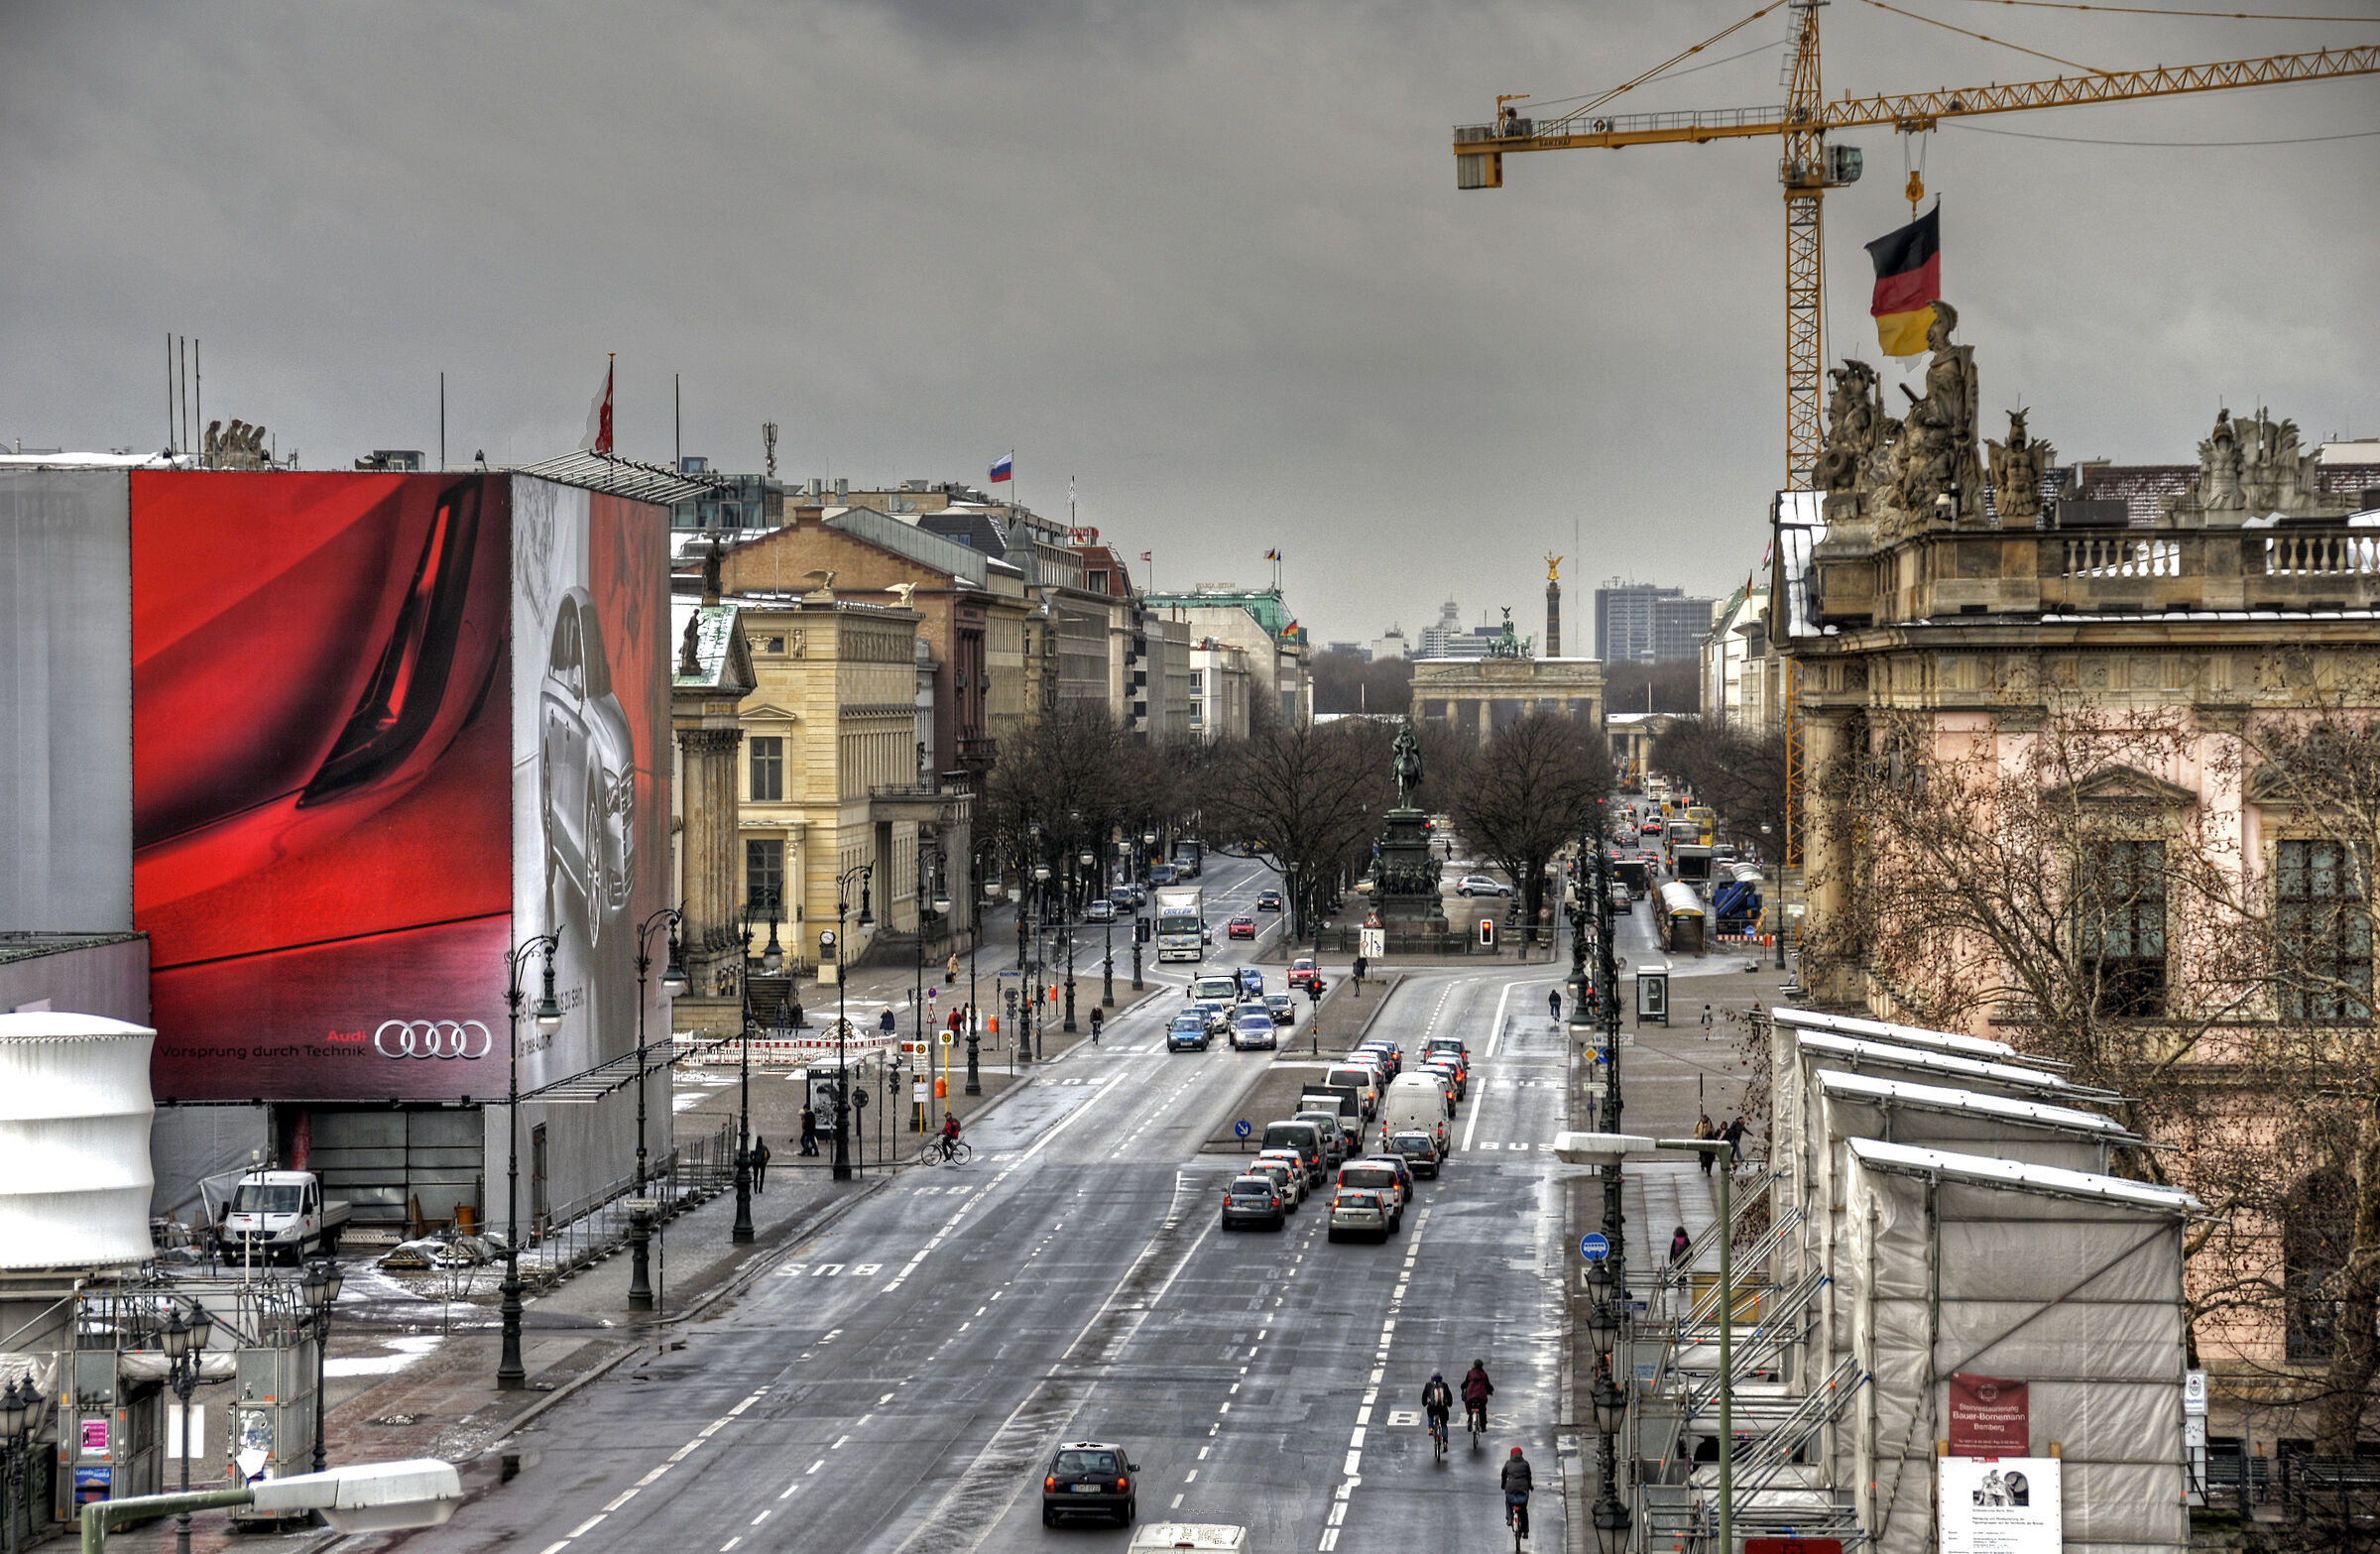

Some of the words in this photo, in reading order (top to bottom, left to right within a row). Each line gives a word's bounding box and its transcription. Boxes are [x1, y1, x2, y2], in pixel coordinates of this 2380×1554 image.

[326, 1030, 366, 1041] Audi
[161, 1045, 247, 1059] Vorsprung
[252, 1045, 299, 1057] durch
[303, 1045, 366, 1057] Technik
[775, 1263, 884, 1277] BUS
[1959, 1403, 2019, 1413] Steinrestaurierung
[1953, 1410, 2026, 1421] Bauer-Bornemann
[1973, 1422, 2005, 1433] Bamberg
